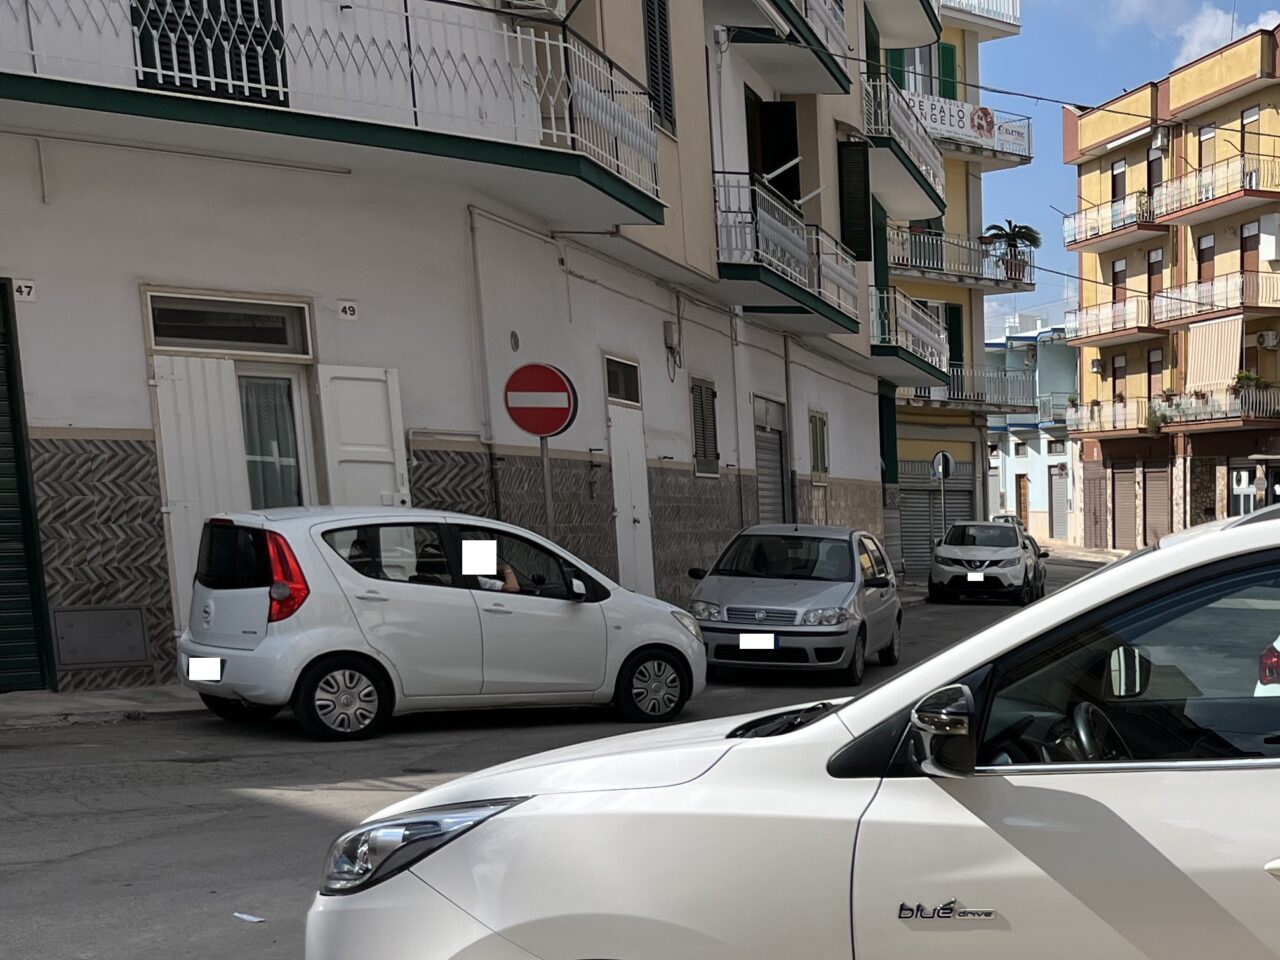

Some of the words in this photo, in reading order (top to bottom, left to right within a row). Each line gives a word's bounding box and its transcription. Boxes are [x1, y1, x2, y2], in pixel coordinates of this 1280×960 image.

[908, 98, 925, 111] DE
[931, 103, 966, 120] PALO
[920, 111, 966, 129] NGELO
[15, 285, 33, 296] 47
[341, 305, 356, 316] 49
[898, 901, 954, 919] blue
